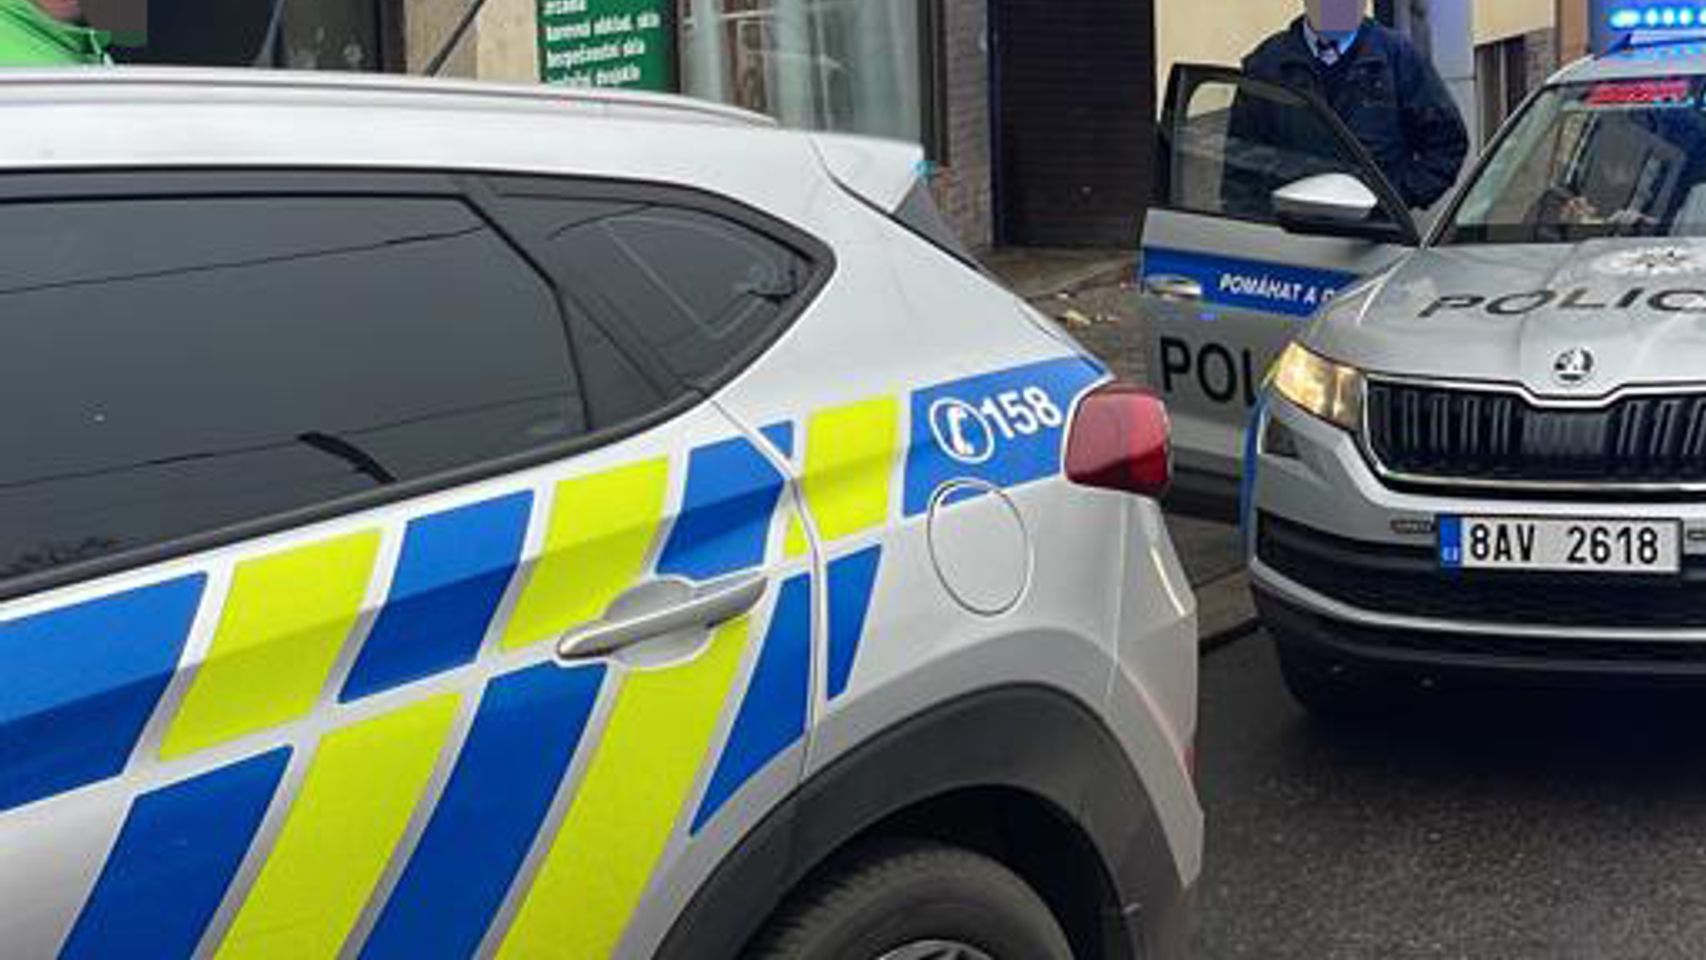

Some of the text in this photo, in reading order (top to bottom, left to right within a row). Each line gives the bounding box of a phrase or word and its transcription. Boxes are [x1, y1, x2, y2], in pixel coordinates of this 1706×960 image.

[1219, 272, 1302, 303] POMÁHAT
[981, 386, 1063, 439] 158
[1469, 523, 1659, 565] 8AV 2618
